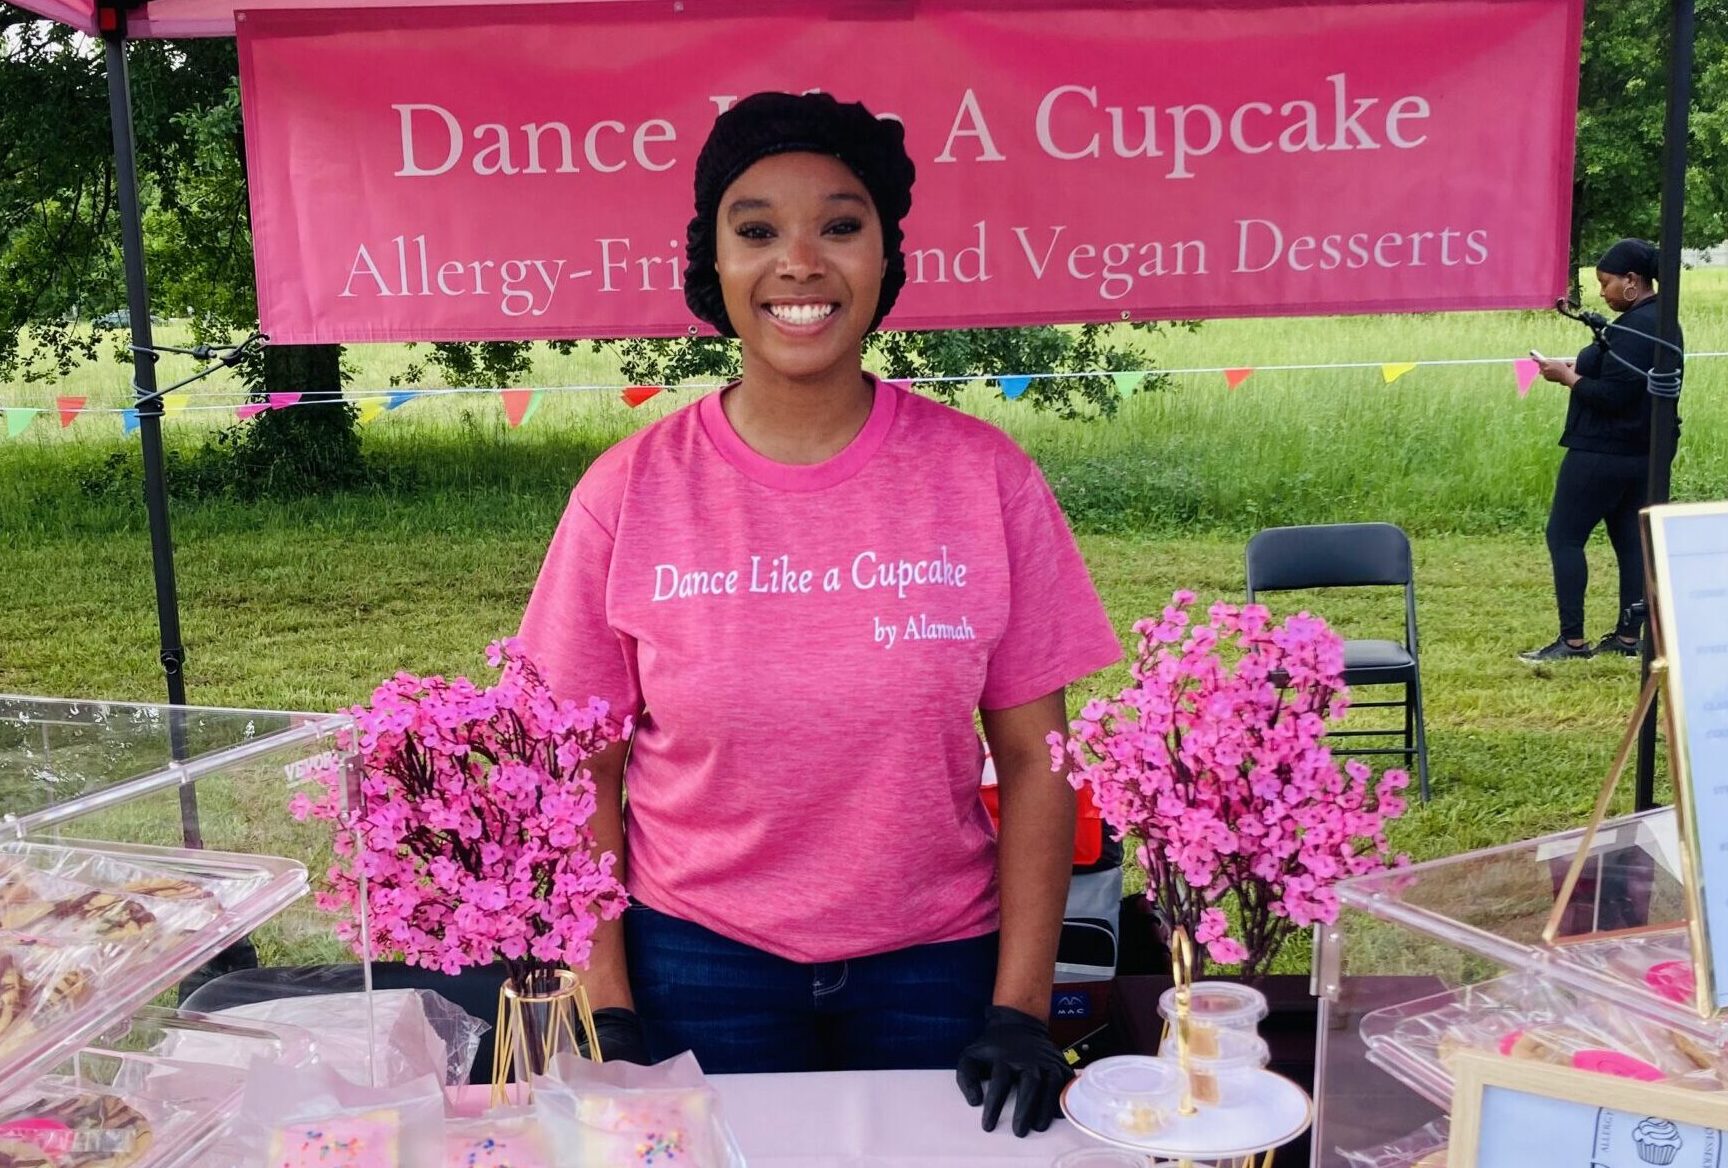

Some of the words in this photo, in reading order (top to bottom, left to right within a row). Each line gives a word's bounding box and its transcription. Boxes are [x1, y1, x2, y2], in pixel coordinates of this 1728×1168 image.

[391, 102, 677, 178] Dance
[934, 88, 1006, 164] A
[1035, 72, 1431, 180] Cupcake
[338, 234, 683, 317] Allergy-Fri
[904, 220, 989, 285] nd
[1011, 225, 1208, 300] Vegan
[1233, 217, 1489, 274] Desserts
[652, 563, 739, 602] Dance
[749, 554, 811, 594] Like
[823, 566, 840, 592] a
[851, 545, 967, 599] Cupcake
[874, 616, 896, 649] by
[903, 613, 976, 641] Alannah
